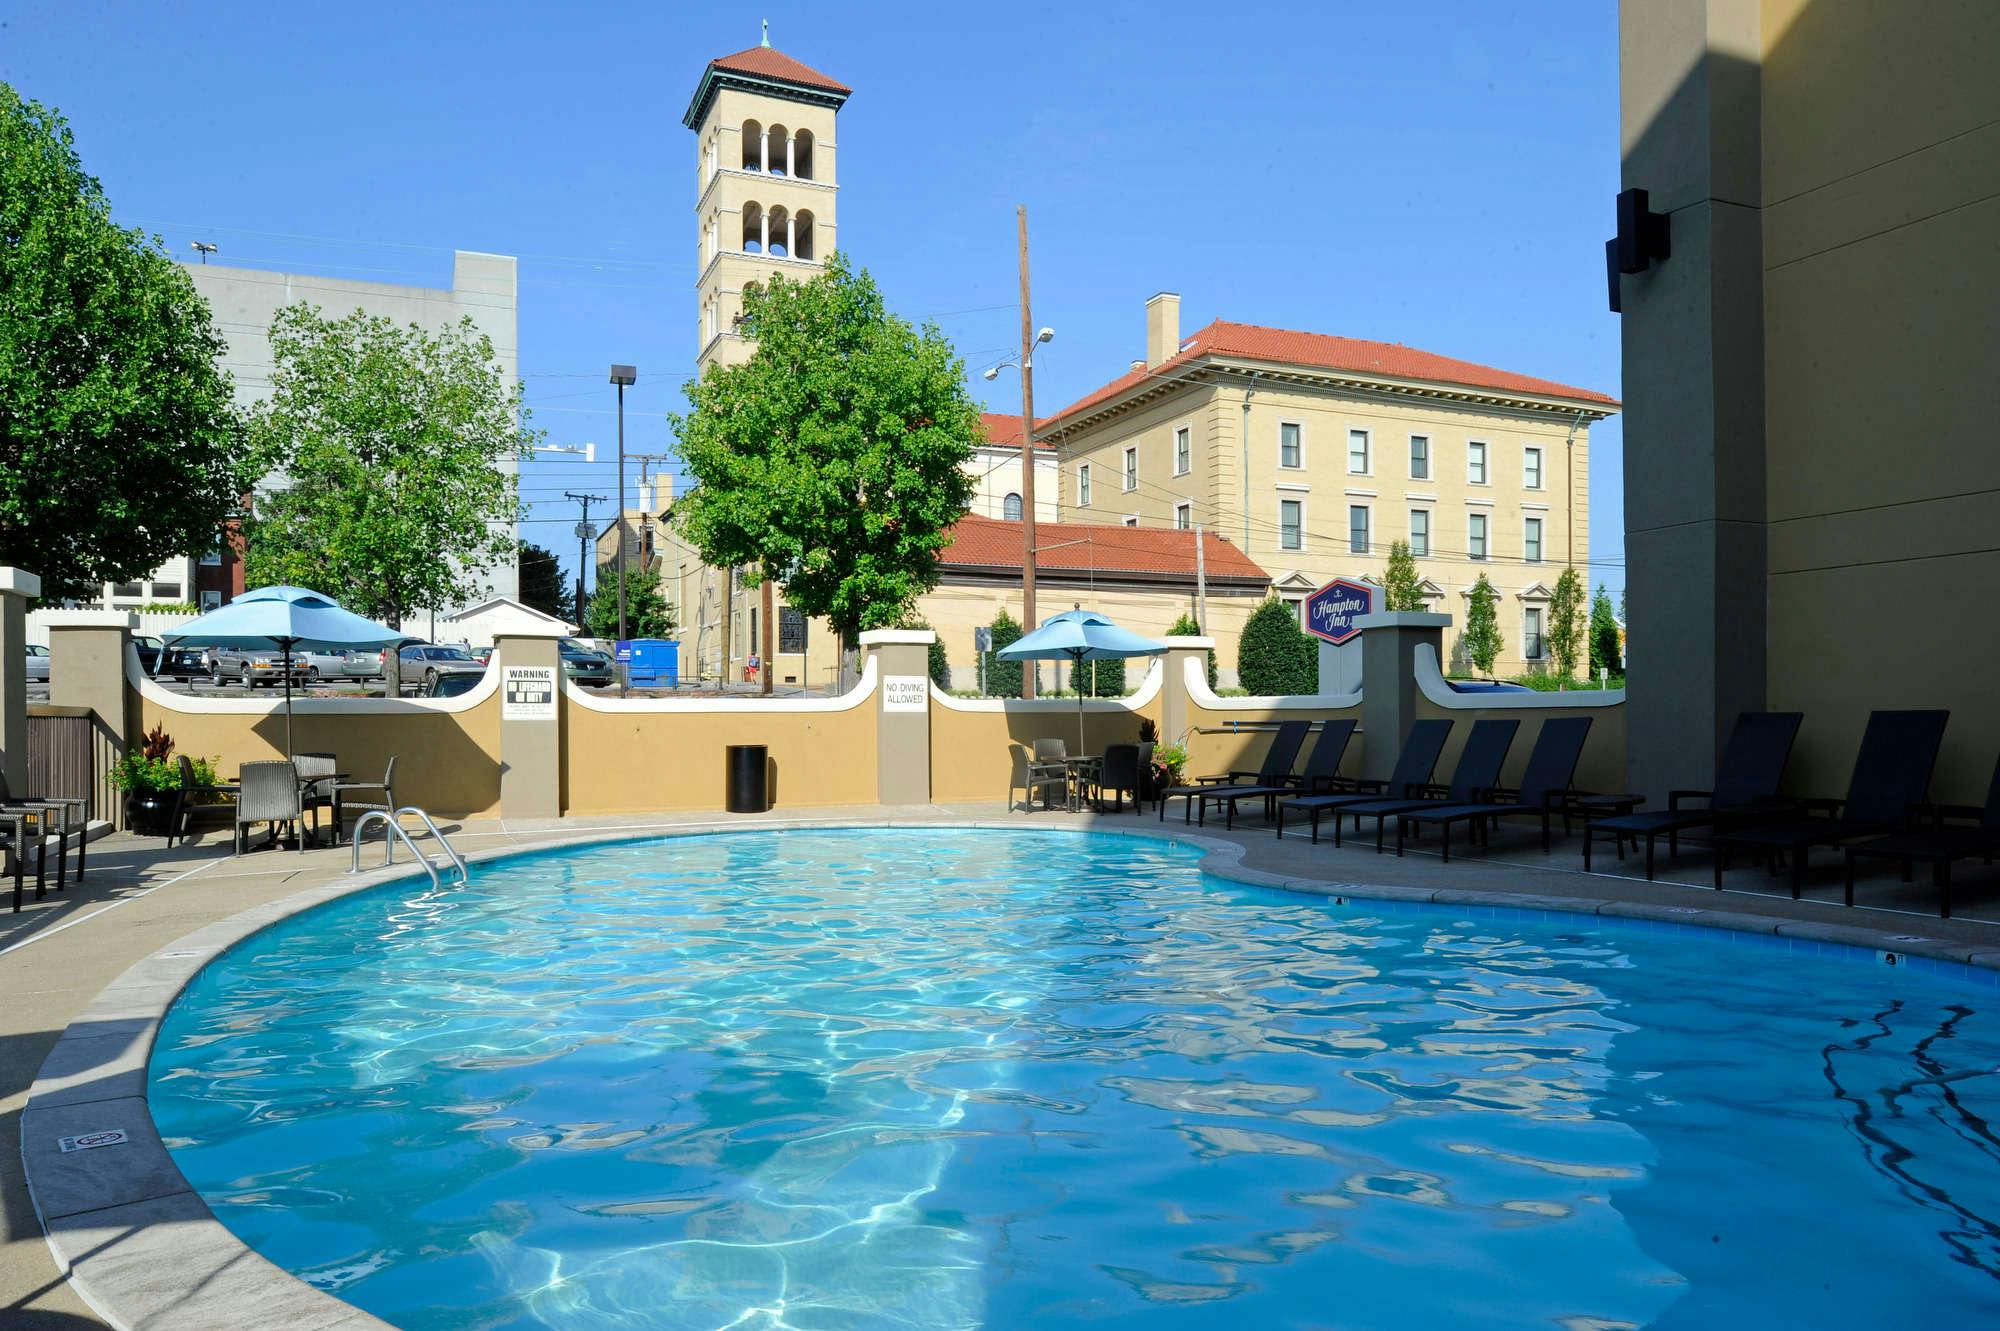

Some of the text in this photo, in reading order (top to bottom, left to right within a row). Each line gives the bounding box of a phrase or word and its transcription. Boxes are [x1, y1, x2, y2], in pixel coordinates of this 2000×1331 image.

[1313, 598, 1364, 619] Hampton
[1325, 613, 1350, 632] Inn
[509, 670, 550, 679] WARNING
[886, 683, 924, 692] NO DIVING
[888, 695, 923, 704] ALLOWED
